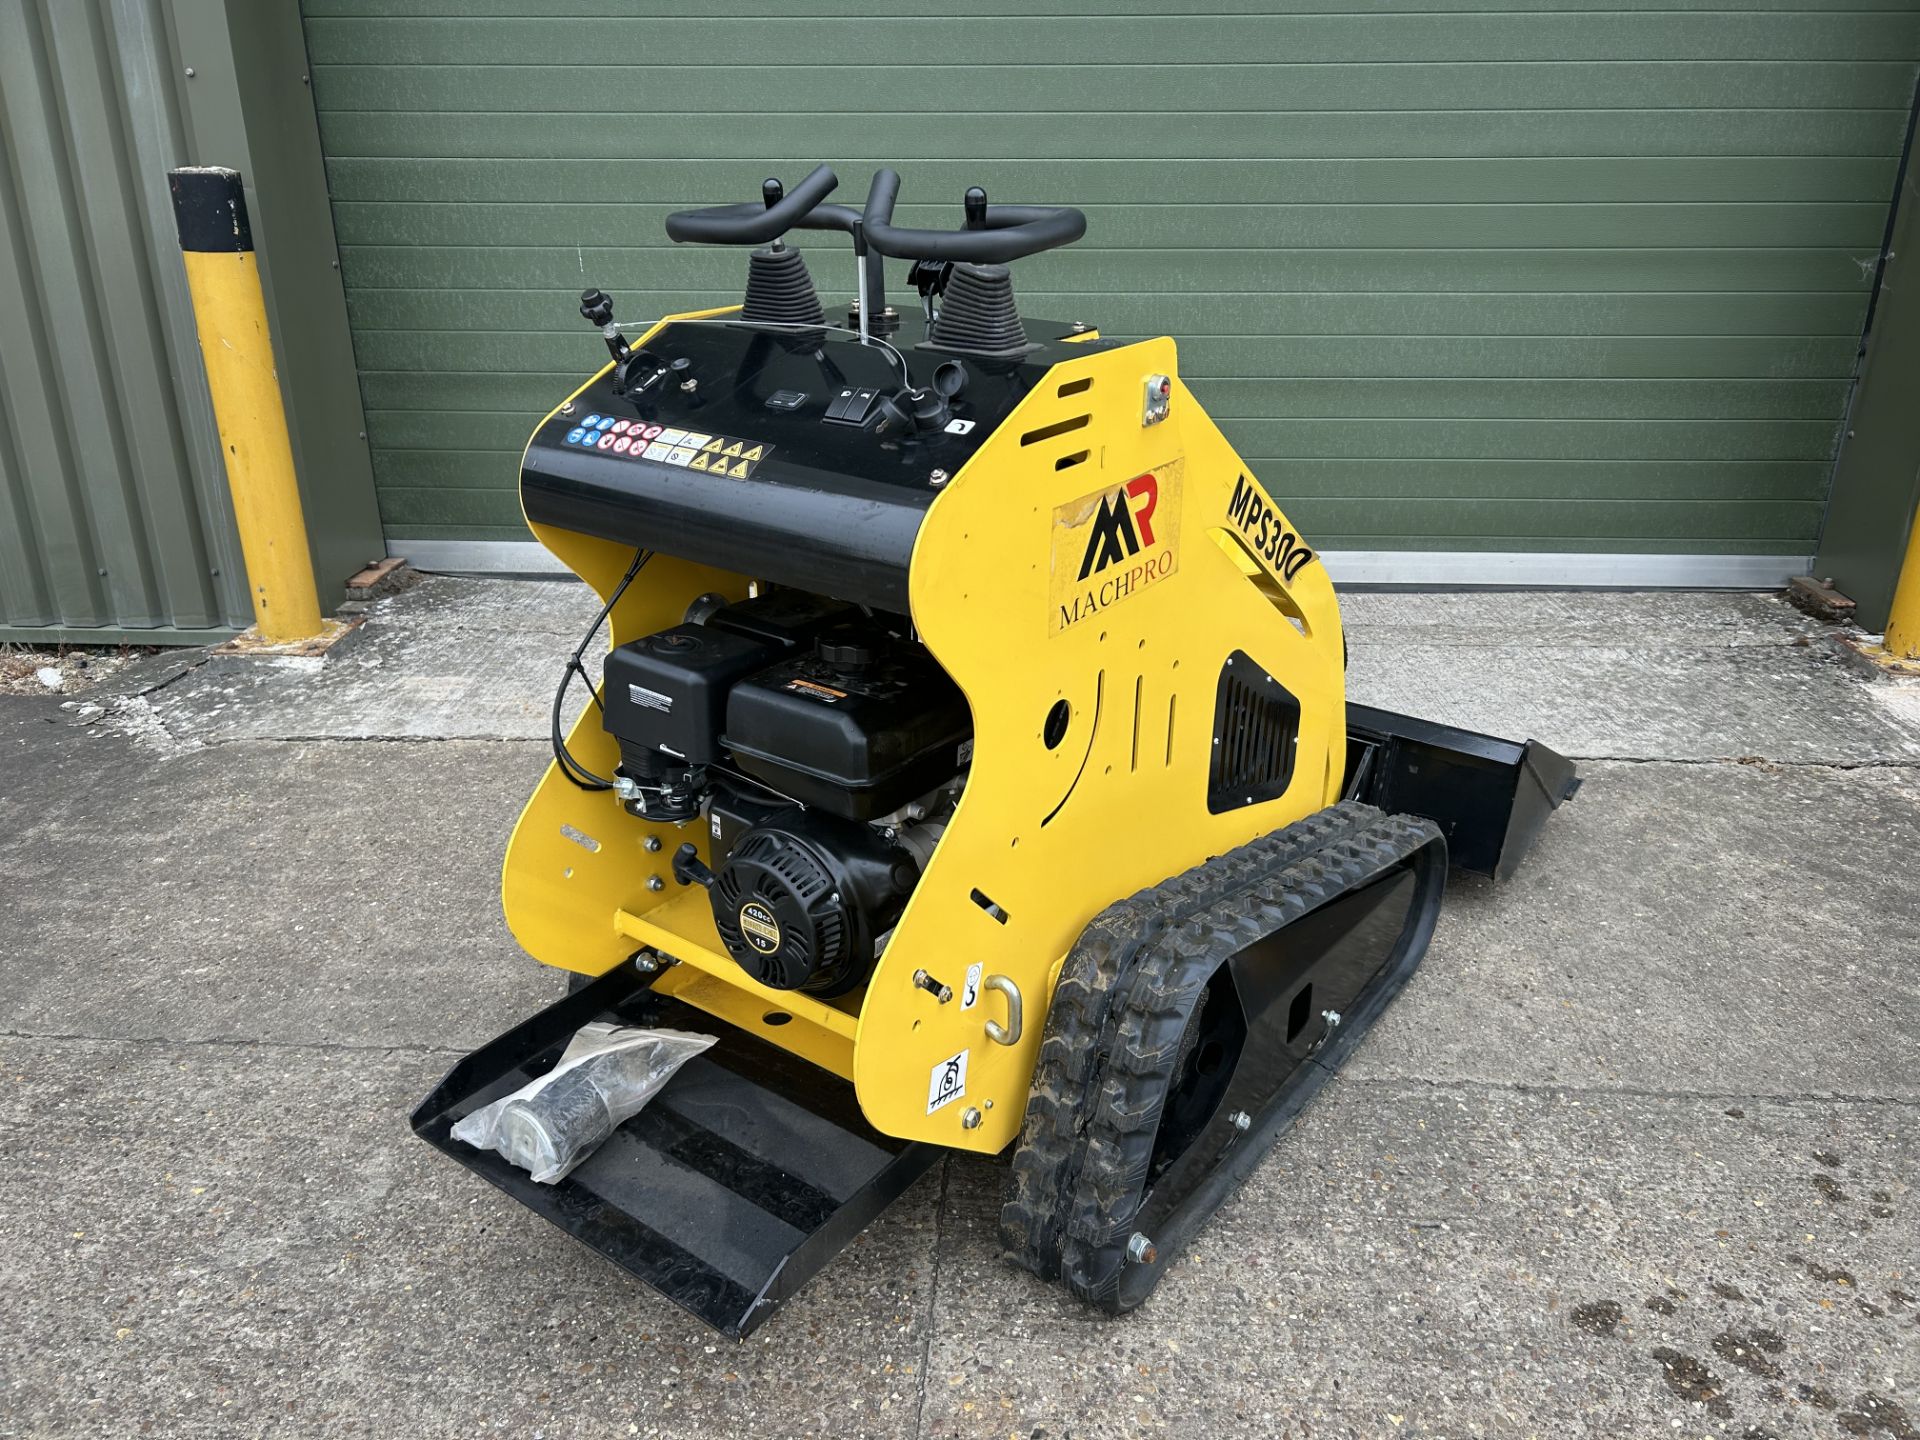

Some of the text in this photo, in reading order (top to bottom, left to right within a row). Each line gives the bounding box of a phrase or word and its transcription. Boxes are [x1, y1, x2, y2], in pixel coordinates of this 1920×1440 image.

[1228, 474, 1312, 581] MPS300
[1060, 550, 1172, 630] MACHPRO
[747, 908, 771, 922] 420cc
[755, 938, 766, 947] 15
